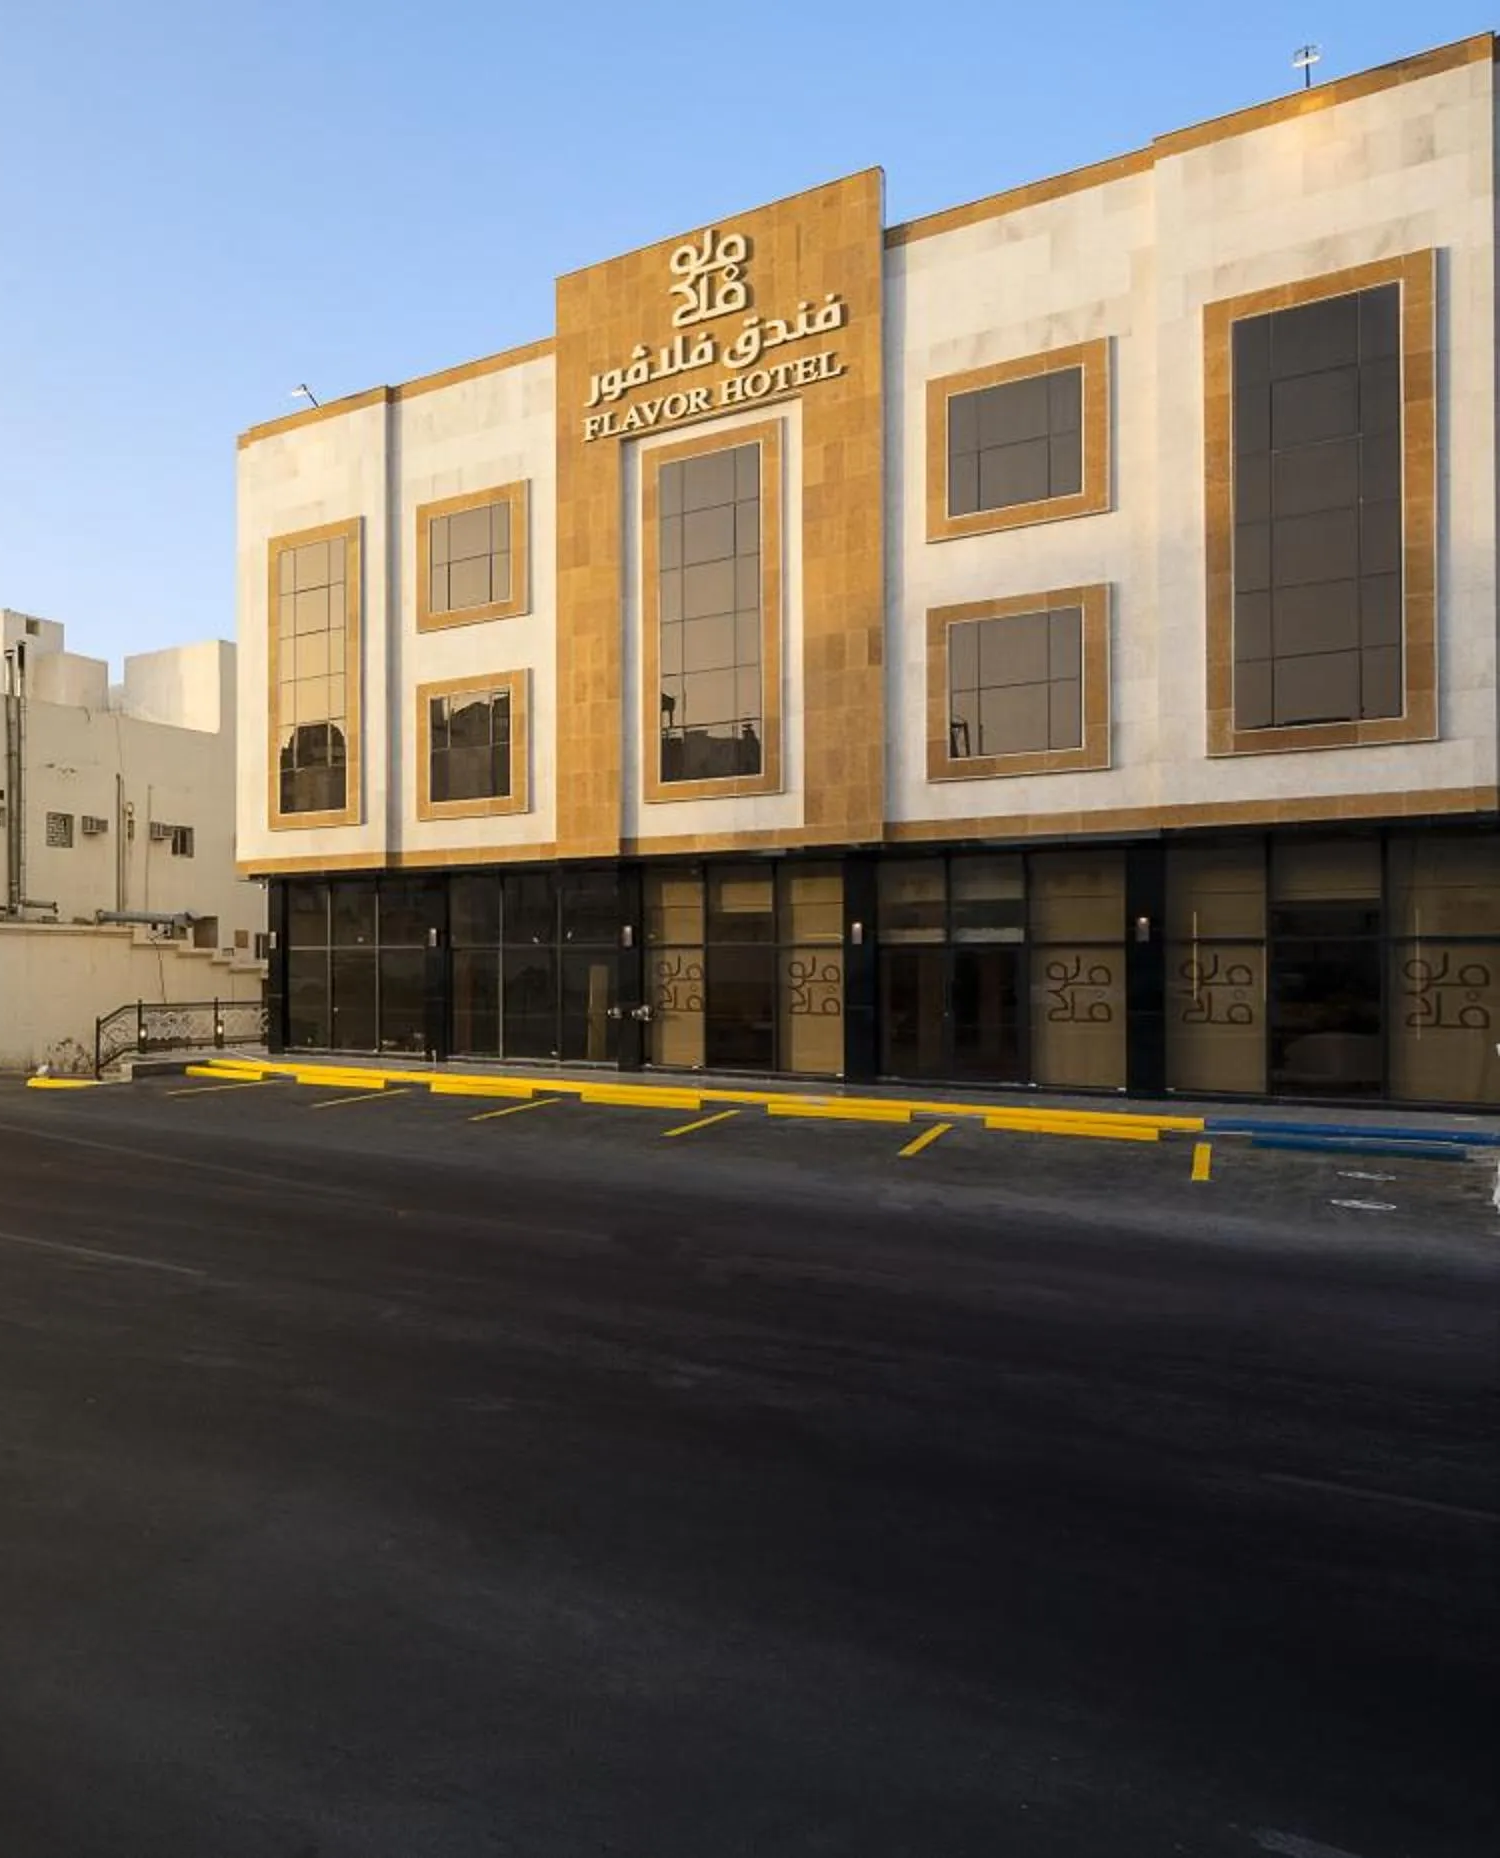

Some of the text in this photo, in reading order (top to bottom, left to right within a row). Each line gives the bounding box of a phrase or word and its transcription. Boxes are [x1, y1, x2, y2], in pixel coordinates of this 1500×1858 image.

[723, 292, 842, 369] فندق
[580, 351, 842, 443] FLAVOR HOTEL
